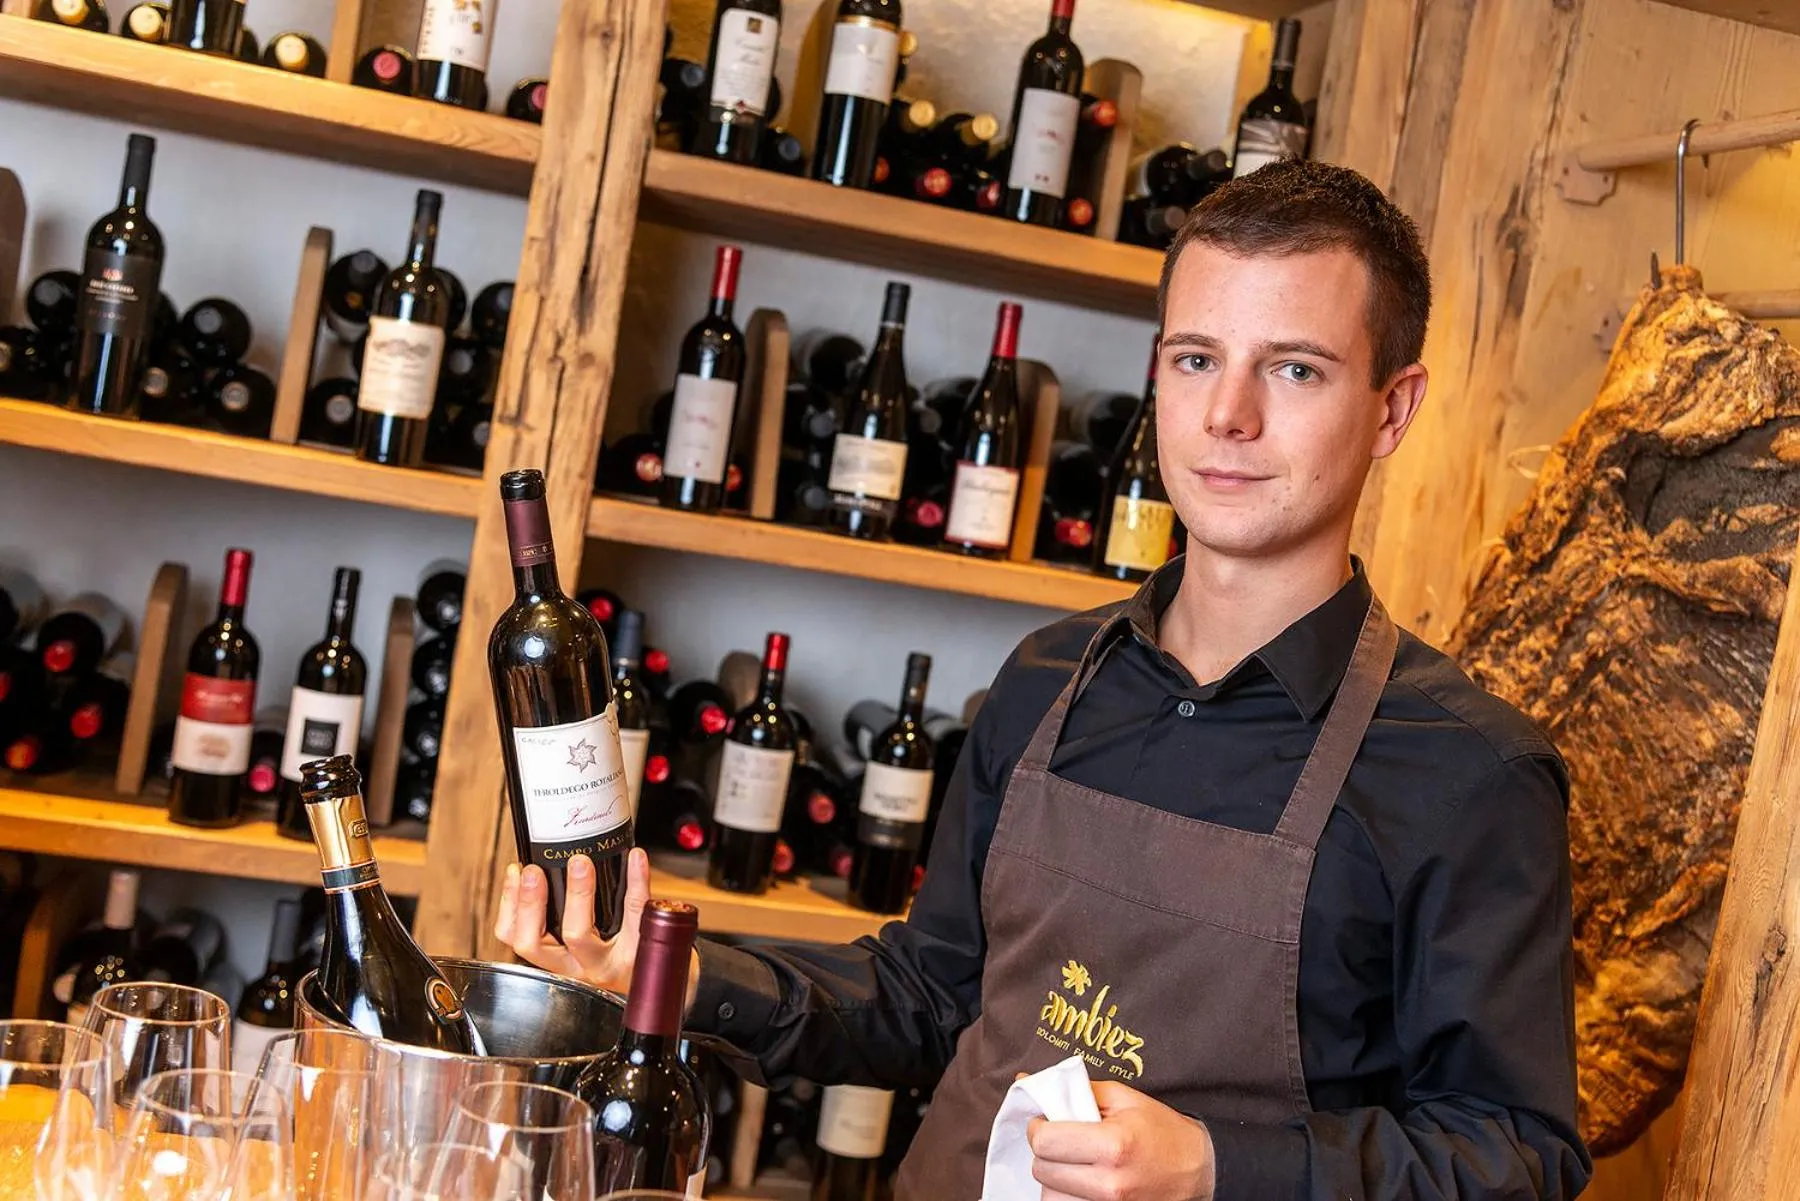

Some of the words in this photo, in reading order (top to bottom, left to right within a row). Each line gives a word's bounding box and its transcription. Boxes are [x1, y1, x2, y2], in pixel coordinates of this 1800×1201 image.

[533, 783, 589, 797] TEROLDEGO
[543, 847, 593, 860] CAMPO
[1040, 985, 1145, 1078] ambiez
[1073, 1047, 1105, 1068] FAMILY
[1108, 1064, 1135, 1081] STYLE
